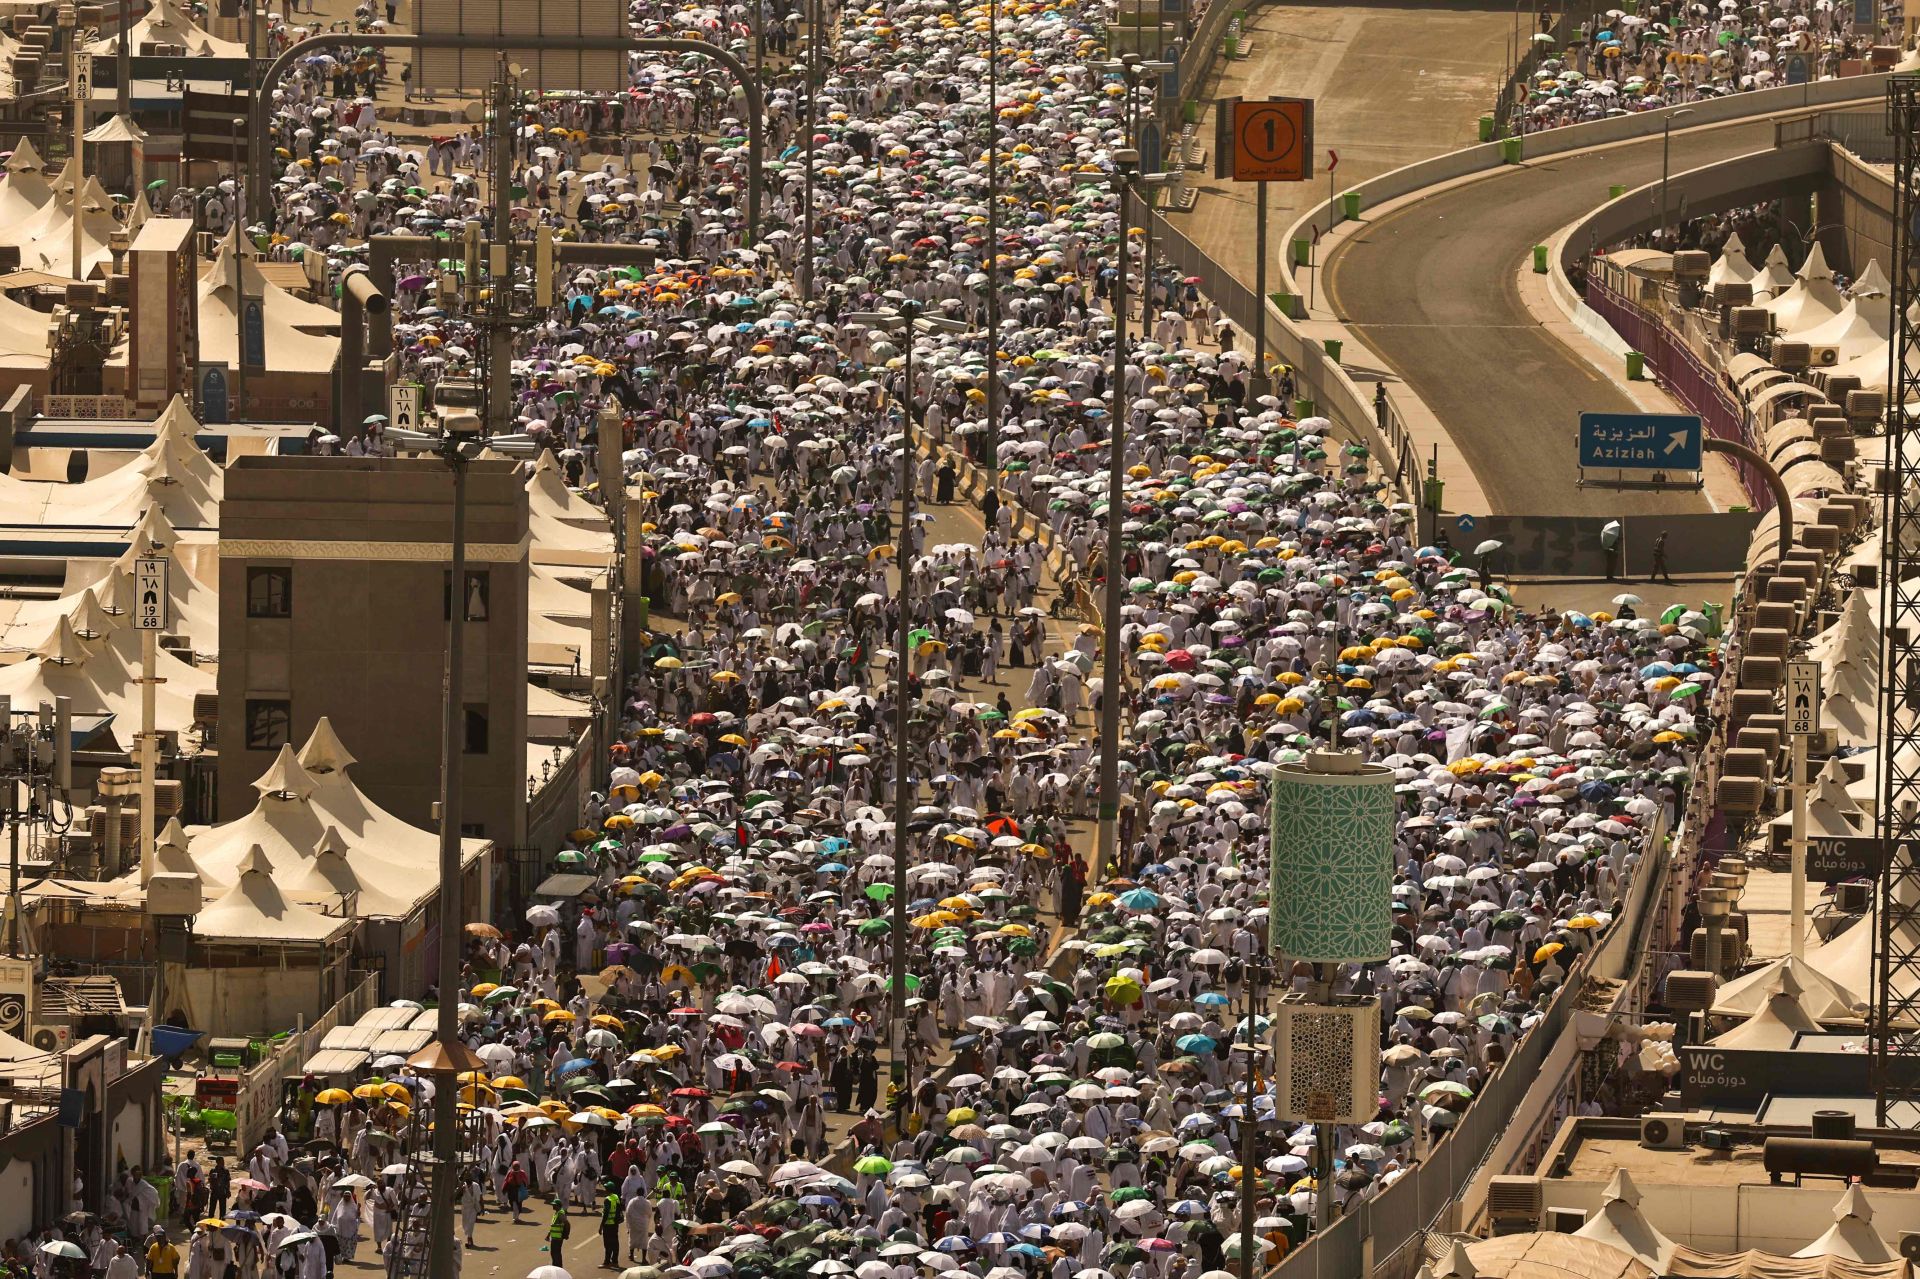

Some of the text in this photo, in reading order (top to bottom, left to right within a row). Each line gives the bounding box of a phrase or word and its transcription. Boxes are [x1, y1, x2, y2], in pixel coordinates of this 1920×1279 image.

[1264, 118, 1275, 152] 1
[399, 388, 408, 398] ٢١
[396, 402, 410, 412] ٦٨
[1593, 424, 1655, 442] العزيزية
[1593, 446, 1655, 460] Aziziah
[144, 562, 156, 574] ١٩
[142, 578, 158, 589] ٦٨
[144, 606, 156, 616] 19
[143, 618, 157, 627] 68
[1796, 666, 1809, 677] ١٠
[1794, 681, 1810, 692] ٦٨
[1798, 710, 1810, 720] 10
[1794, 722, 1809, 732] 68
[1816, 840, 1847, 856] WC
[1814, 856, 1866, 872] دورة مياه
[1690, 1053, 1725, 1070] WC
[1688, 1072, 1746, 1088] دورة مياه
